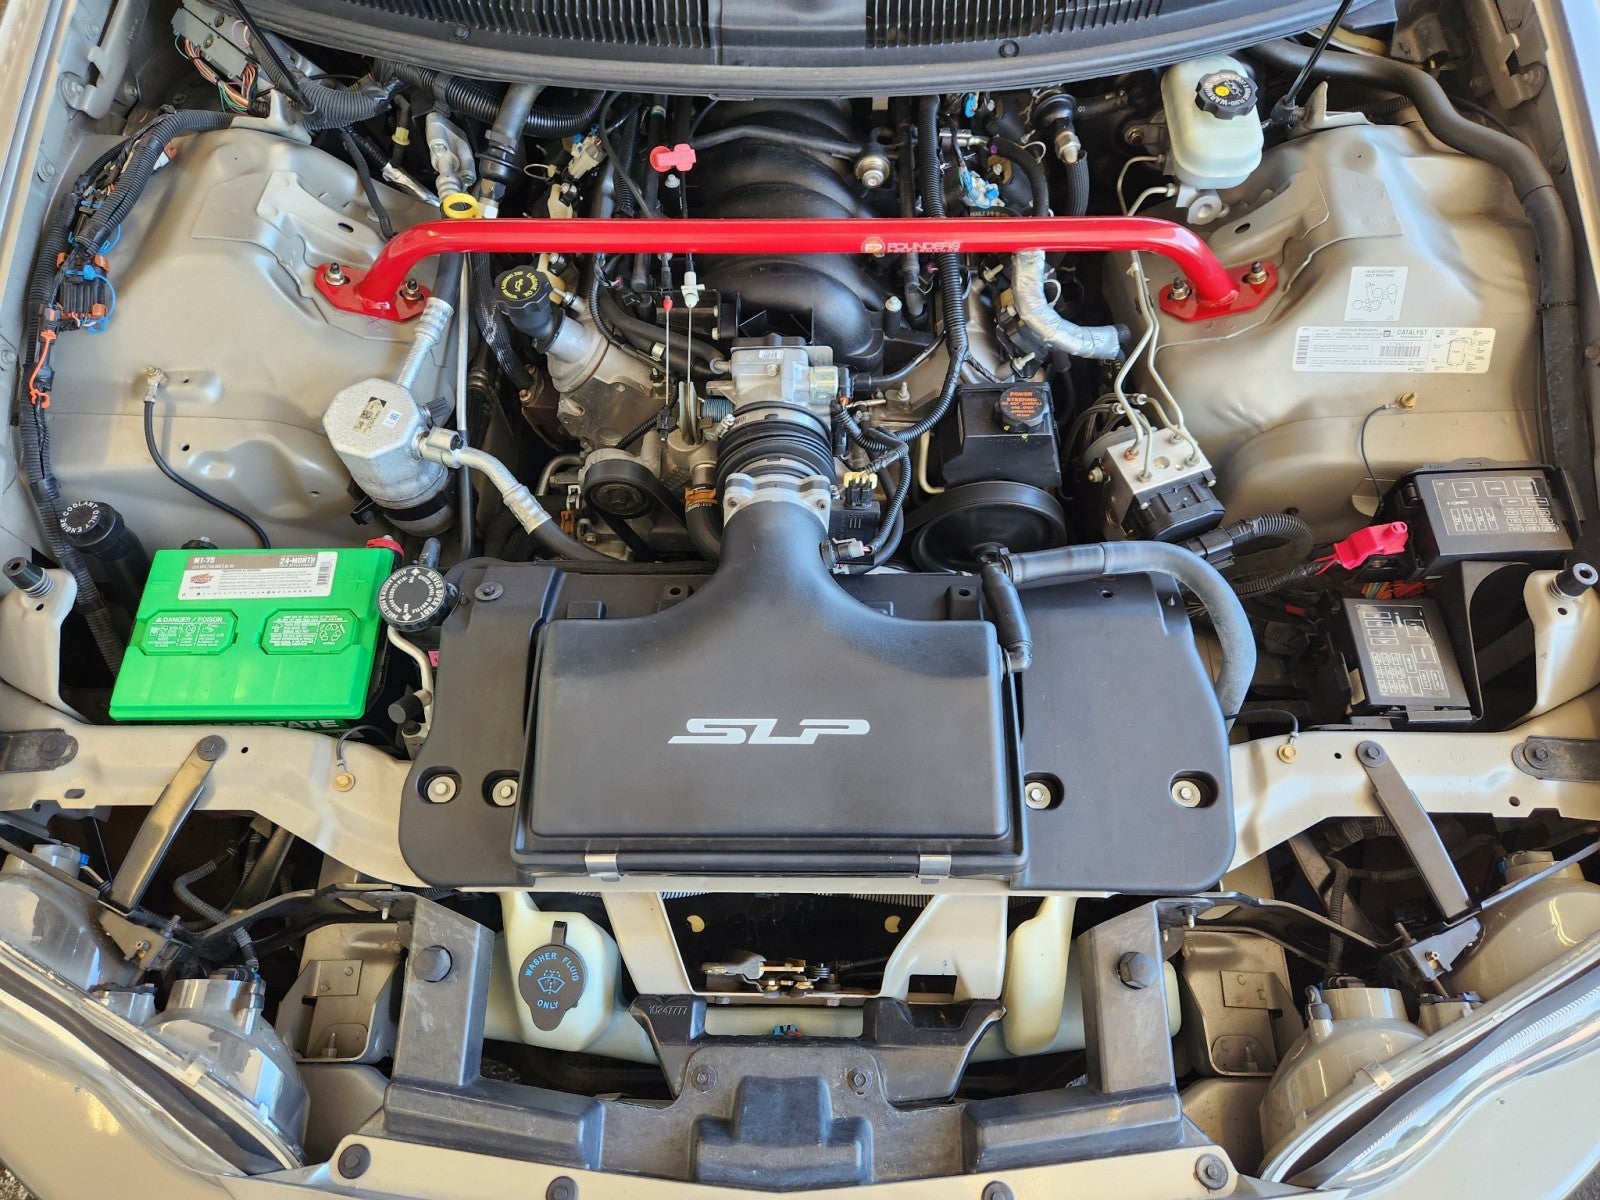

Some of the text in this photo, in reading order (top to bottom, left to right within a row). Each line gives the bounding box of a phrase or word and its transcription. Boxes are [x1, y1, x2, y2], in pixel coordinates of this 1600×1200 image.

[1204, 84, 1227, 105] WARNING
[887, 241, 960, 252] FOUNDERS
[522, 272, 539, 298] ENGINE OIL
[60, 501, 100, 534] ENGINE COOLANT ONLY
[193, 556, 216, 564] MT-75
[279, 556, 317, 565] 24-MONTH
[419, 571, 443, 619] NEVER OPEN HOT
[667, 718, 871, 745] SLP
[525, 952, 580, 982] WASHER FLUID
[537, 999, 559, 1010] ONLY
